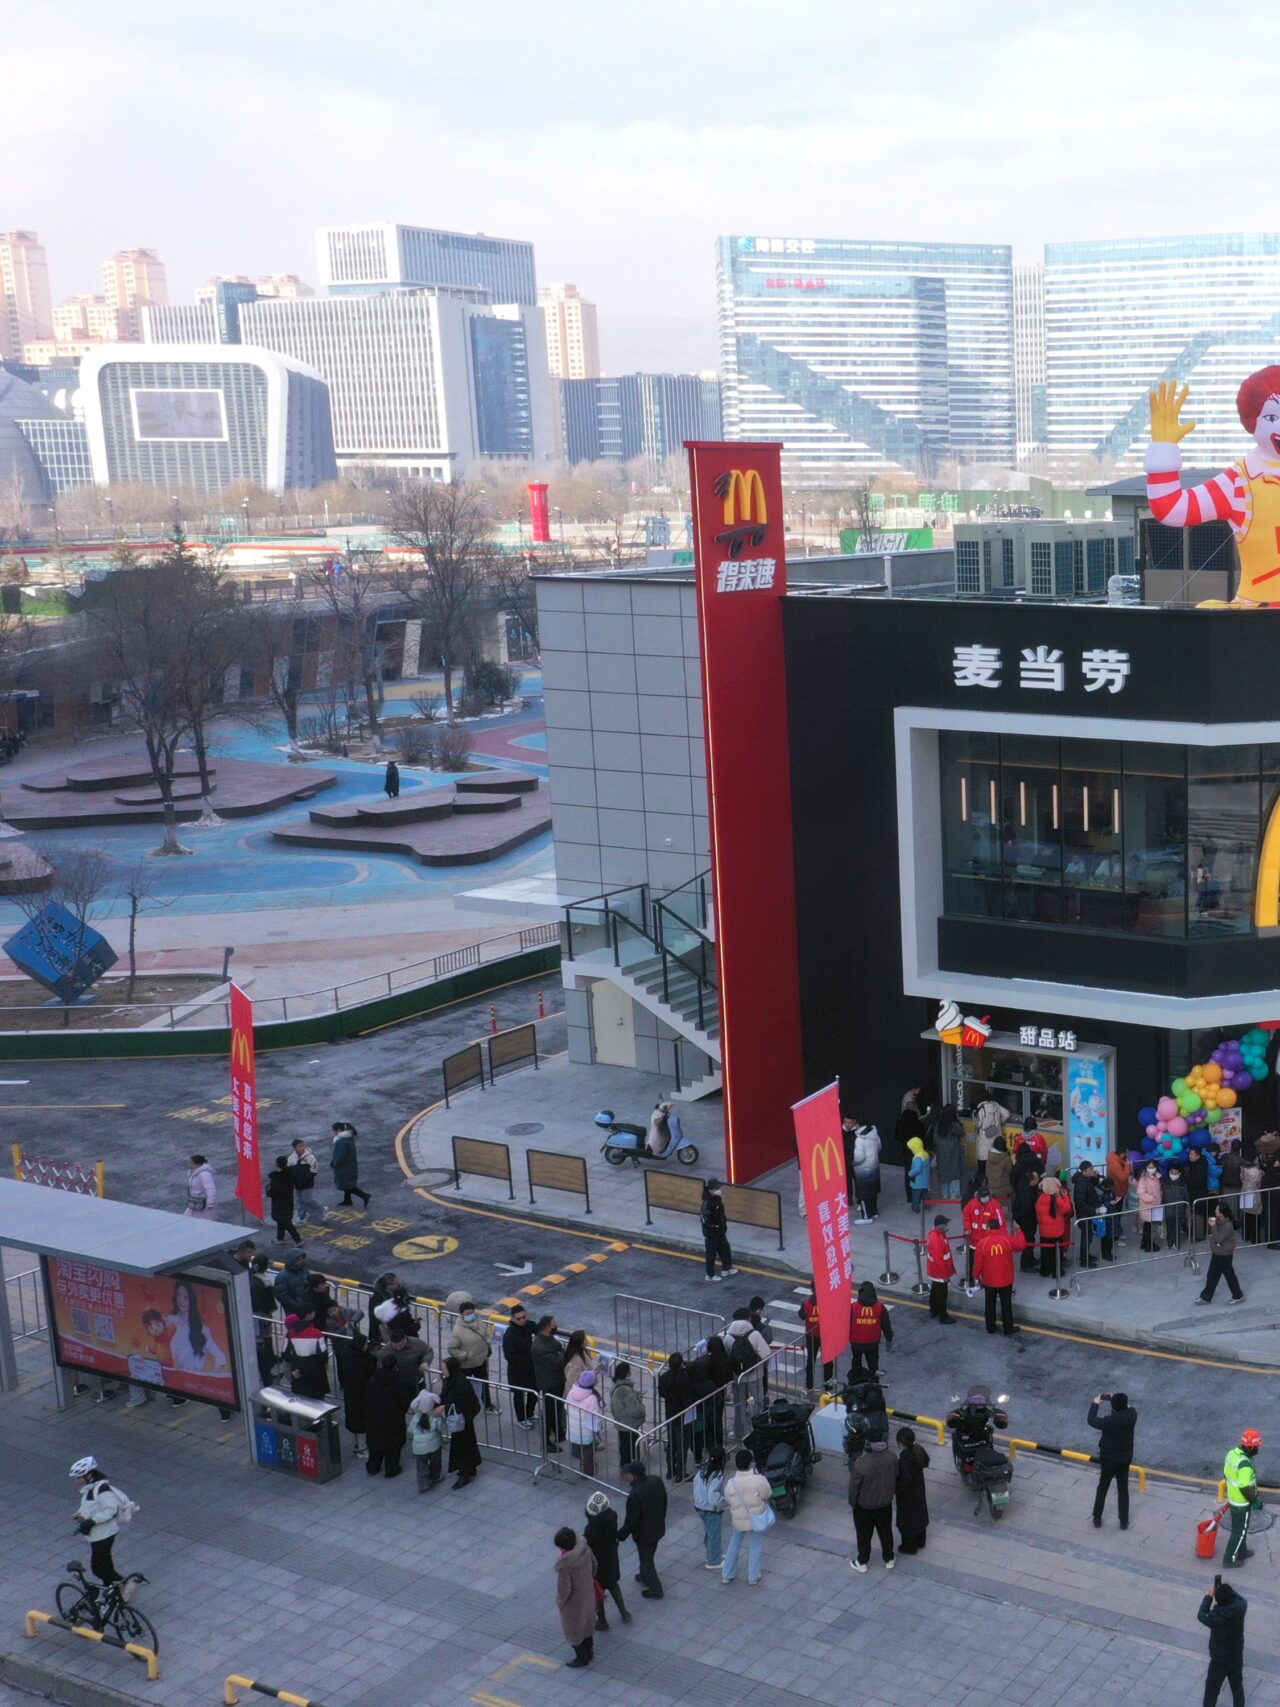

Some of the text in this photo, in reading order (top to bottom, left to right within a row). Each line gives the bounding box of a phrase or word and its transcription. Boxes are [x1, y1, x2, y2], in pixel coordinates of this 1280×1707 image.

[716, 558, 777, 593] 得来速
[953, 643, 1131, 694] 麦当劳
[1020, 1025, 1078, 1051] 甜品站
[56, 1259, 121, 1290] 淘宝闪购
